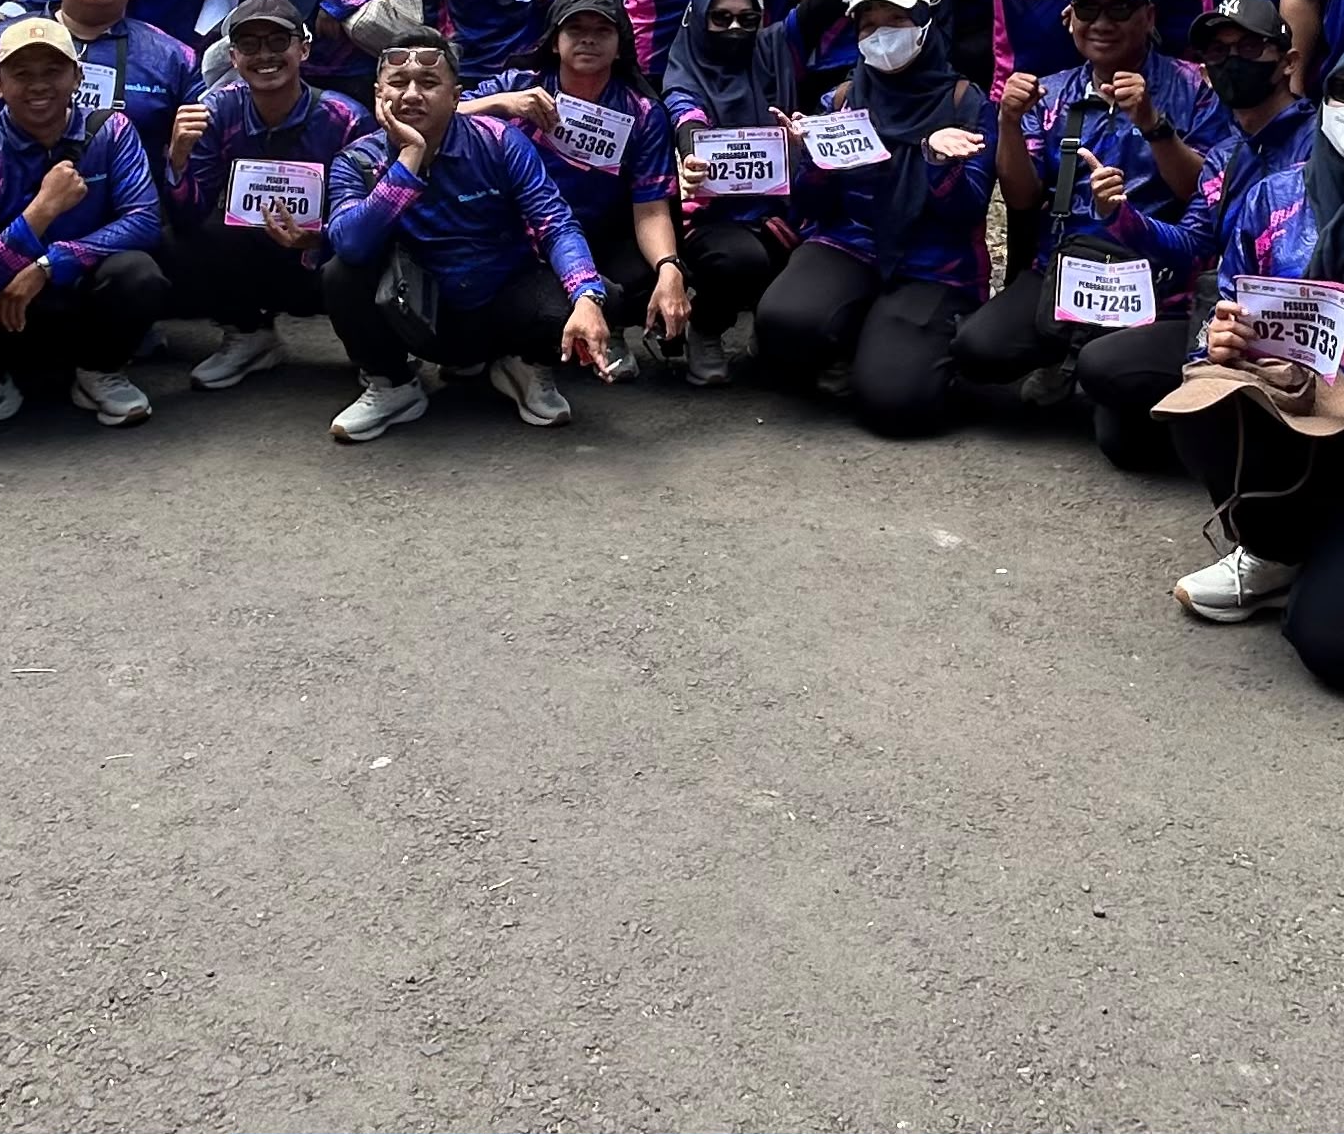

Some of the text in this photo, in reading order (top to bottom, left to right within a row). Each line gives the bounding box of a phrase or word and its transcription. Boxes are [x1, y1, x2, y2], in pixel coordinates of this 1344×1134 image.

[554, 125, 617, 159] 01-3386
[816, 136, 874, 157] 02-5724
[707, 160, 774, 181] 02-5731
[1073, 290, 1142, 313] 01-7245
[1283, 300, 1319, 313] PESERTA
[1252, 320, 1338, 362] 02-5733
